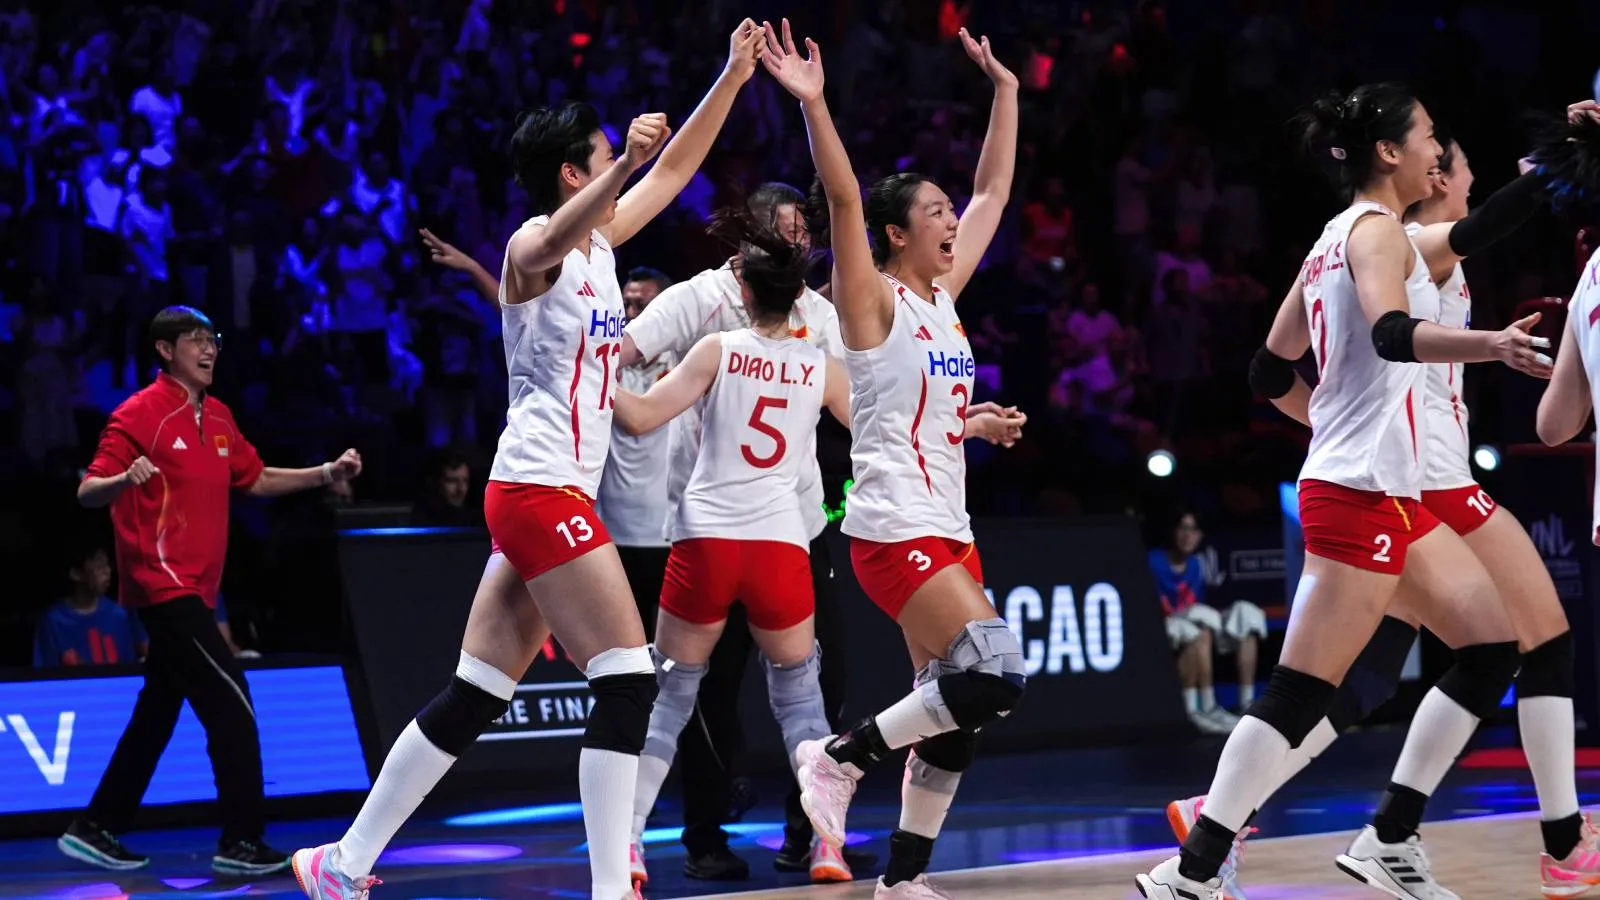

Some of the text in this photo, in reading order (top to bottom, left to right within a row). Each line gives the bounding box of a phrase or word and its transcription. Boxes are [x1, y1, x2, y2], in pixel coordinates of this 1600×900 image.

[727, 351, 815, 387] DIAO L.Y.
[927, 349, 974, 377] Haie
[945, 383, 968, 446] 3
[740, 395, 788, 469] 5
[1466, 489, 1496, 517] 10
[555, 515, 594, 548] 13
[1372, 533, 1392, 563] 2
[907, 549, 932, 572] 3
[984, 582, 1124, 677] CAO
[0, 711, 76, 785] V
